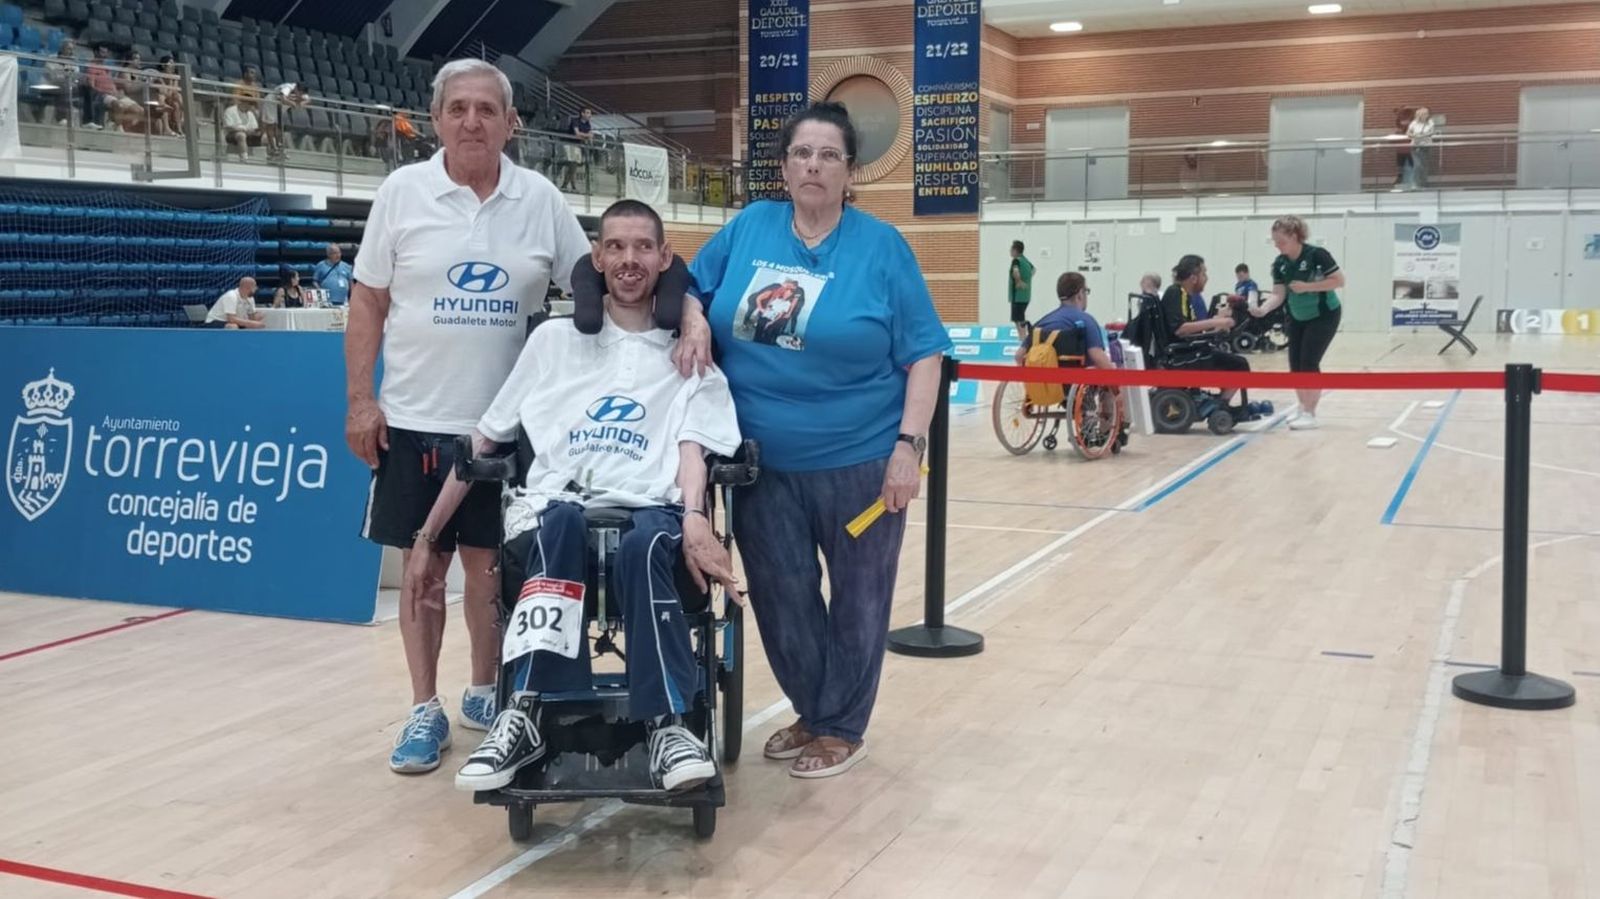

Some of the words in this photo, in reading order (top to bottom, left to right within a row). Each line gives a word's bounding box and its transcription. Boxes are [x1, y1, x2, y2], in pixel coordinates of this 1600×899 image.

[760, 7, 783, 16] GALA
[785, 6, 799, 15] DEL
[917, 2, 977, 18] DEPORTE
[752, 14, 806, 30] DEPORTE
[926, 42, 968, 59] 21/22
[760, 53, 799, 69] 20/21
[755, 92, 803, 103] RESPETO
[915, 92, 978, 105] ESFUERZO
[916, 105, 972, 116] DISCIPLINA
[921, 116, 976, 127] SACRIFICIO
[915, 125, 976, 142] PASIÓN
[917, 143, 969, 151] SOLIDARIDAD
[915, 150, 976, 161] SUPERACIÓN
[916, 161, 977, 172] HUMILDAD
[915, 172, 978, 186] RESPETO
[918, 186, 969, 196] ENTREGA
[433, 297, 519, 314] HYUNDAI
[433, 315, 487, 327] Guadalete
[490, 317, 517, 327] Motor
[102, 415, 181, 432] Ayuntamiento
[569, 426, 649, 451] HYUNDAI
[84, 424, 329, 502] torrevieja
[108, 490, 219, 525] concejalía
[228, 494, 257, 524] de
[126, 522, 253, 565] deportes
[516, 605, 563, 637] 302
